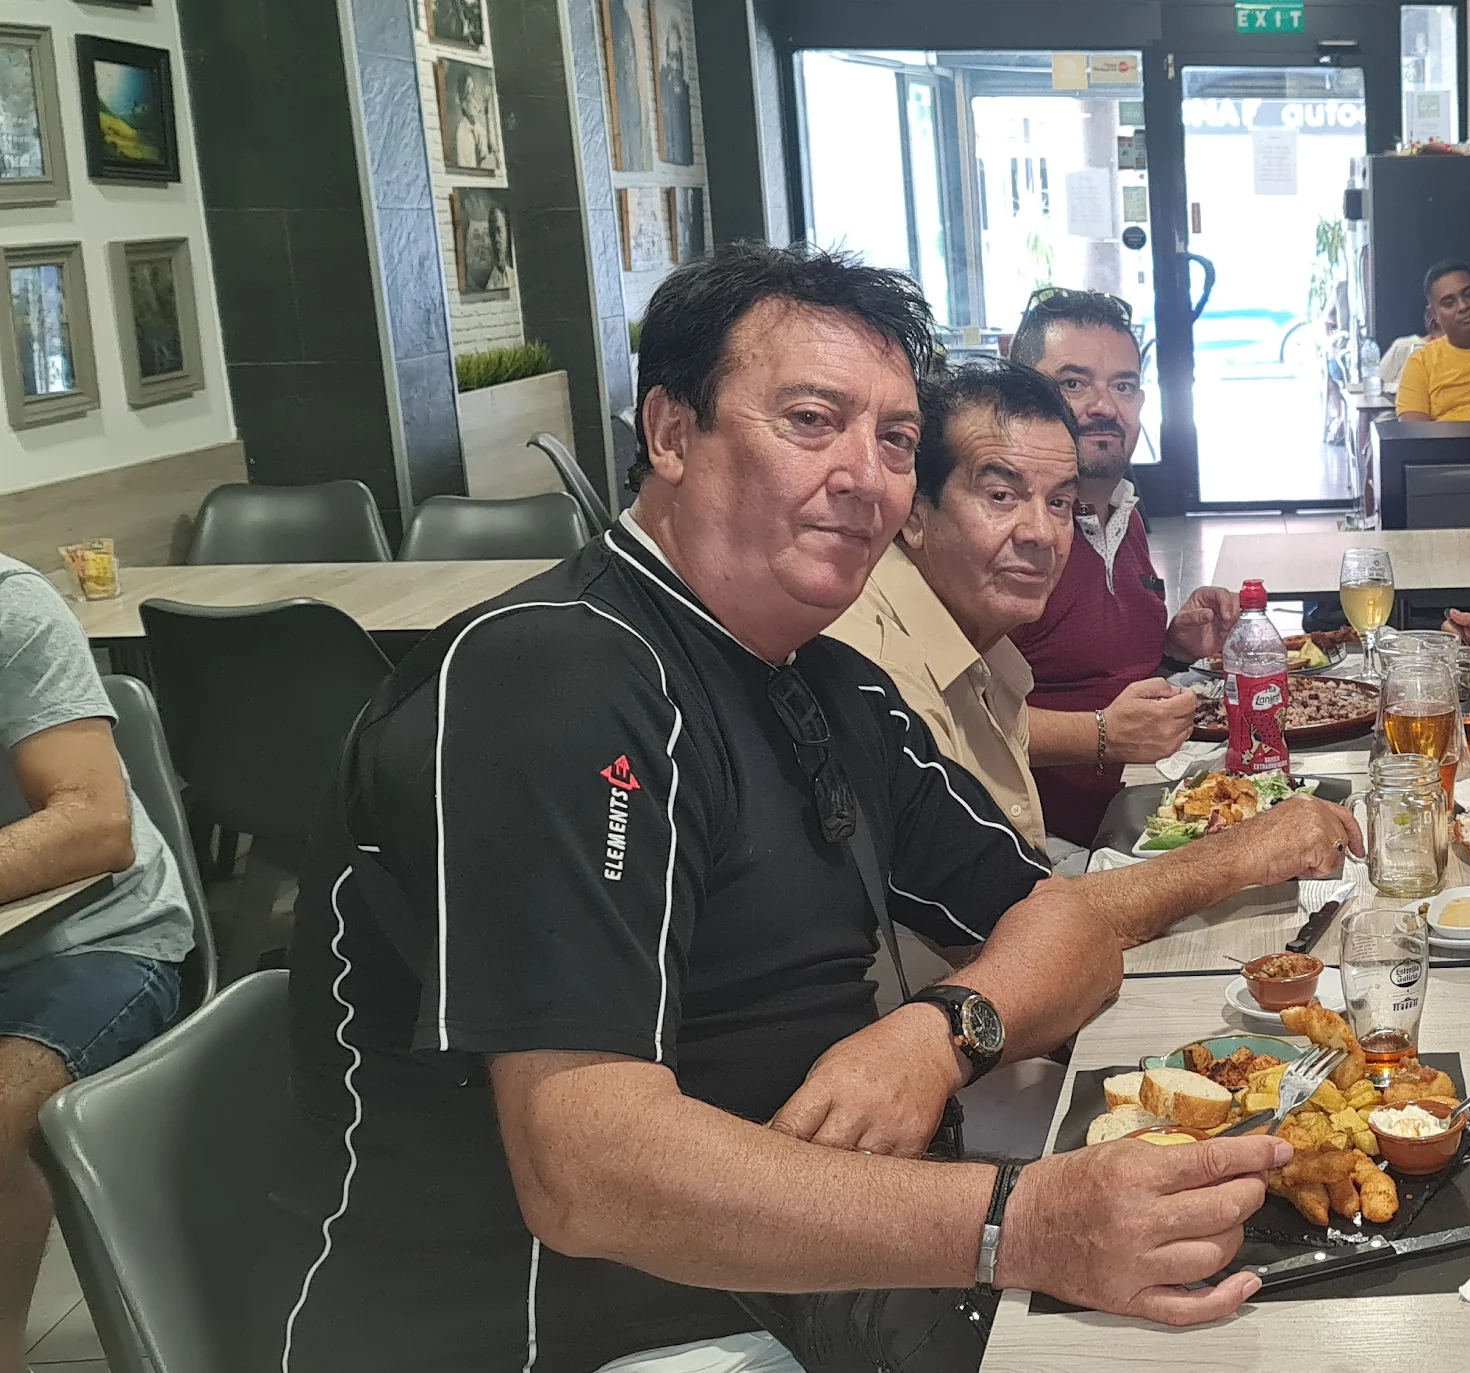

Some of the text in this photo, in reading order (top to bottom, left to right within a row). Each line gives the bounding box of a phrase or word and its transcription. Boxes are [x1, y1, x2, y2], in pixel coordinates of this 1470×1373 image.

[1237, 10, 1302, 28] EXIT
[603, 786, 629, 881] ELEMENTS
[1395, 965, 1420, 977] Estrella
